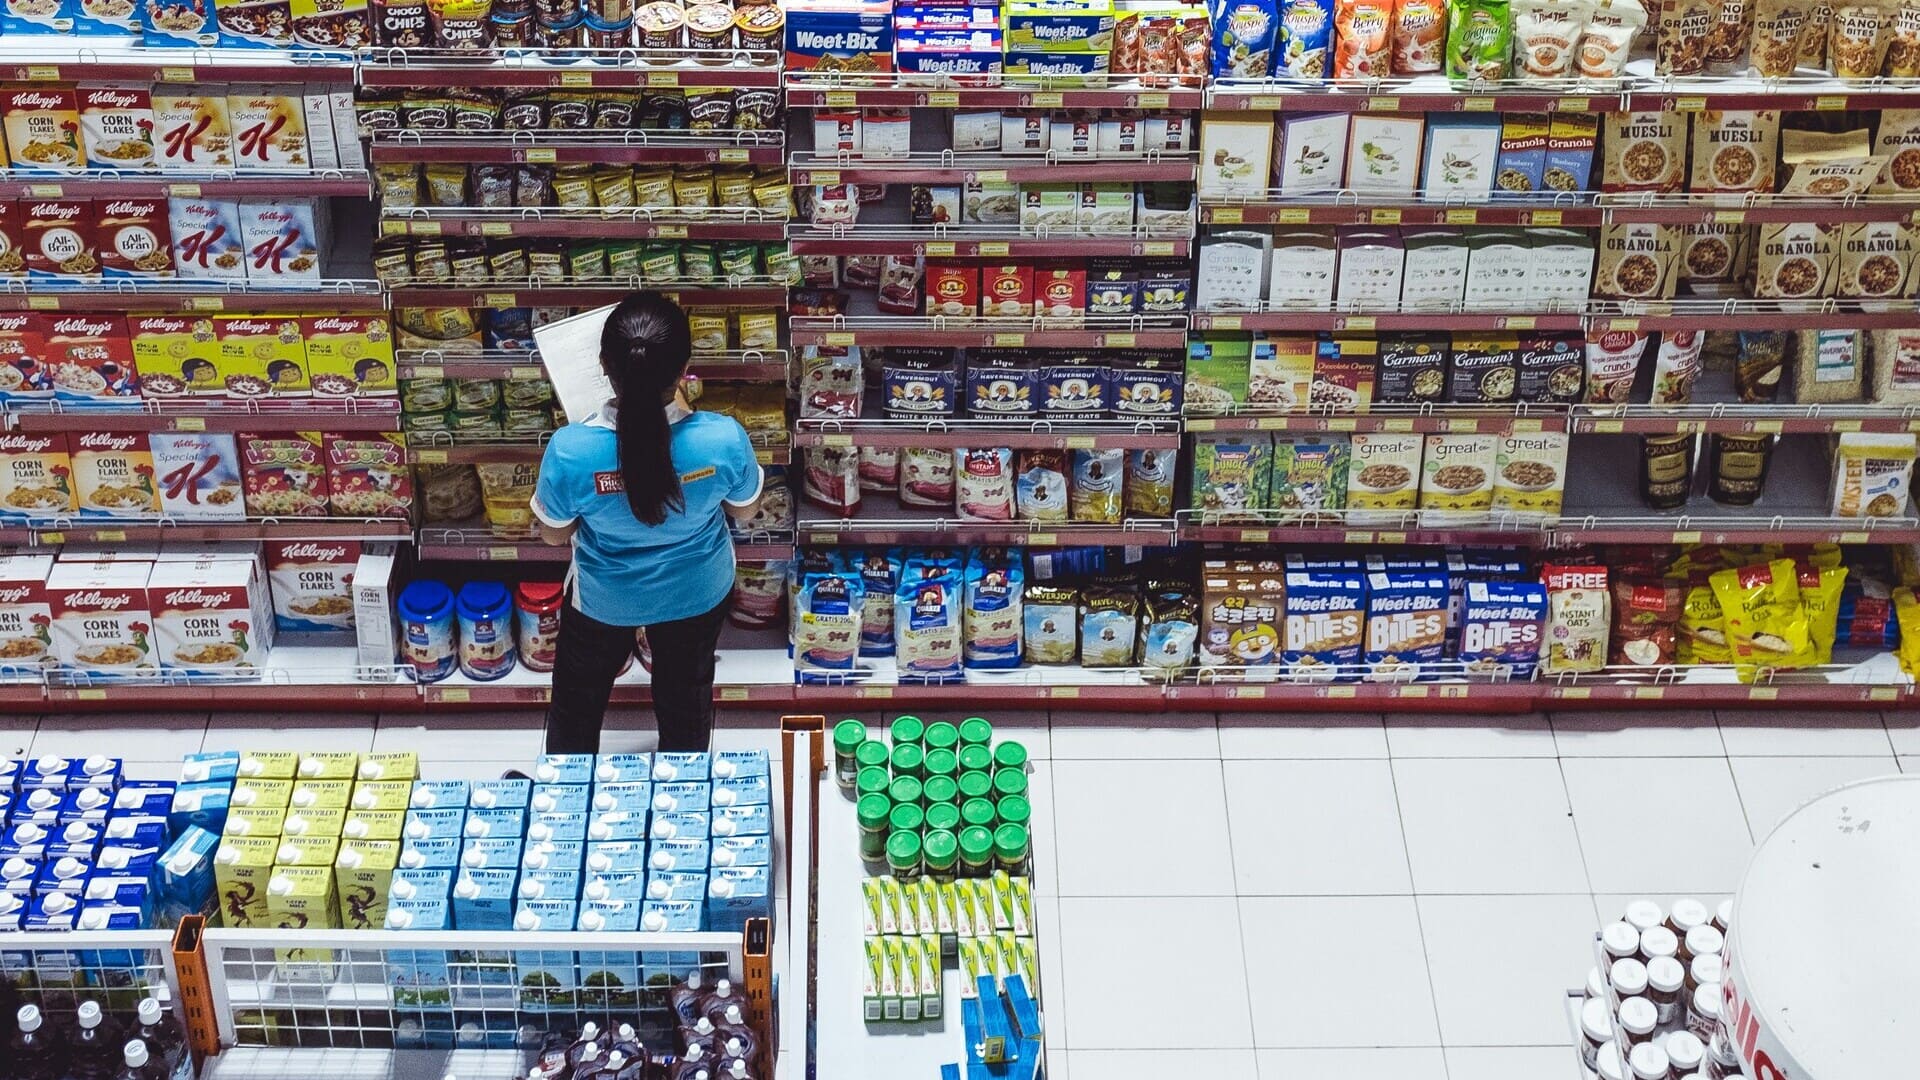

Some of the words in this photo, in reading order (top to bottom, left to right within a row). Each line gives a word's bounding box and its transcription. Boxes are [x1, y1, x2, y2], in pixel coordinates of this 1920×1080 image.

[387, 7, 421, 16] CHOCO
[385, 16, 426, 30] CHIPS
[444, 20, 477, 28] CHOCO
[923, 15, 971, 23] Weet-Bix
[1353, 16, 1383, 29] Berry
[1403, 13, 1434, 27] Berry
[1834, 14, 1892, 29] GRANOLA
[442, 28, 483, 41] CHIPS
[1034, 26, 1088, 38] Weet-Bix
[1681, 26, 1707, 35] BITES
[1846, 28, 1875, 37] BITES
[796, 31, 879, 50] Weet-Bix
[918, 59, 982, 73] Weet-Bix
[1030, 62, 1084, 74] Weet-Bix
[12, 93, 63, 107] Kellogg's
[88, 91, 138, 106] Kellogg's
[28, 116, 54, 126] CORN
[101, 114, 133, 126] CORN
[160, 112, 193, 122] Special
[235, 111, 268, 122] Special
[29, 125, 56, 134] FLAKES
[103, 125, 135, 135] FLAKES
[1620, 125, 1673, 139] MUESLI
[163, 115, 212, 163] K
[240, 115, 287, 162] K
[1709, 130, 1763, 143] MUESLI
[1502, 138, 1546, 150] Granola
[1549, 138, 1594, 149] Granola
[1810, 167, 1864, 176] MUESLI
[31, 203, 80, 219] Kellogg's
[105, 201, 155, 217] Kellogg's
[185, 205, 219, 216] Kellogg's
[258, 211, 295, 222] Kellogg's
[177, 219, 209, 231] Special
[1683, 224, 1743, 236] RANOLA
[249, 226, 283, 237] Special
[53, 235, 72, 246] All-
[127, 233, 146, 243] All-
[48, 243, 76, 254] Bran
[122, 241, 150, 251] Bran
[180, 225, 226, 268] K
[1607, 238, 1671, 251] GRANOLA
[1766, 243, 1831, 256] GRANOLA
[1847, 240, 1912, 252] GRANOLA
[253, 229, 301, 274] K
[1207, 252, 1256, 265] Granola
[54, 318, 112, 335] Kellogg's
[140, 318, 185, 331] Kellogg's
[226, 320, 272, 333] Kellogg's
[314, 318, 359, 332] Kellogg's
[693, 320, 723, 329] ENERGEN
[907, 360, 929, 368] Ligo
[992, 359, 1014, 367] Ligo
[1384, 353, 1442, 367] Carman's
[1455, 352, 1514, 367] Carman's
[1522, 351, 1580, 367] Carman's
[1350, 363, 1375, 371] Cherry
[1603, 361, 1631, 372] crunch
[895, 374, 939, 382] HAVERMOUT
[980, 374, 1024, 382] HAVERMOUT
[1052, 372, 1096, 380] HAVERMOUT
[1124, 376, 1167, 384] HAVERMOUT
[80, 432, 136, 448] Kellogg's
[1506, 438, 1549, 454] great
[1361, 441, 1404, 459] great
[1436, 441, 1478, 460] great
[97, 459, 127, 468] CORN
[158, 453, 199, 463] Special
[12, 460, 43, 470] CORN
[14, 470, 45, 478] FLAKES
[98, 468, 129, 476] FLAKES
[163, 454, 220, 505] K
[282, 543, 346, 561] Kellogg's
[299, 571, 334, 582] CORN
[1562, 573, 1607, 588] FREE
[300, 582, 335, 590] FLAKES
[64, 591, 130, 610] Kellogg's
[165, 588, 232, 608] Kellogg's
[1287, 596, 1358, 611] Weet-Bix
[1371, 596, 1442, 612] Weet-Bix
[916, 605, 941, 613] QUAKER
[1468, 607, 1539, 620] Weet-Bix
[1560, 609, 1596, 619] INSTANT
[184, 618, 219, 630] CORN
[816, 615, 838, 623] GRATIS
[1566, 618, 1590, 627] OATS
[83, 620, 119, 631] CORN
[85, 630, 121, 639] FLAKES
[185, 629, 222, 638] FLAKES
